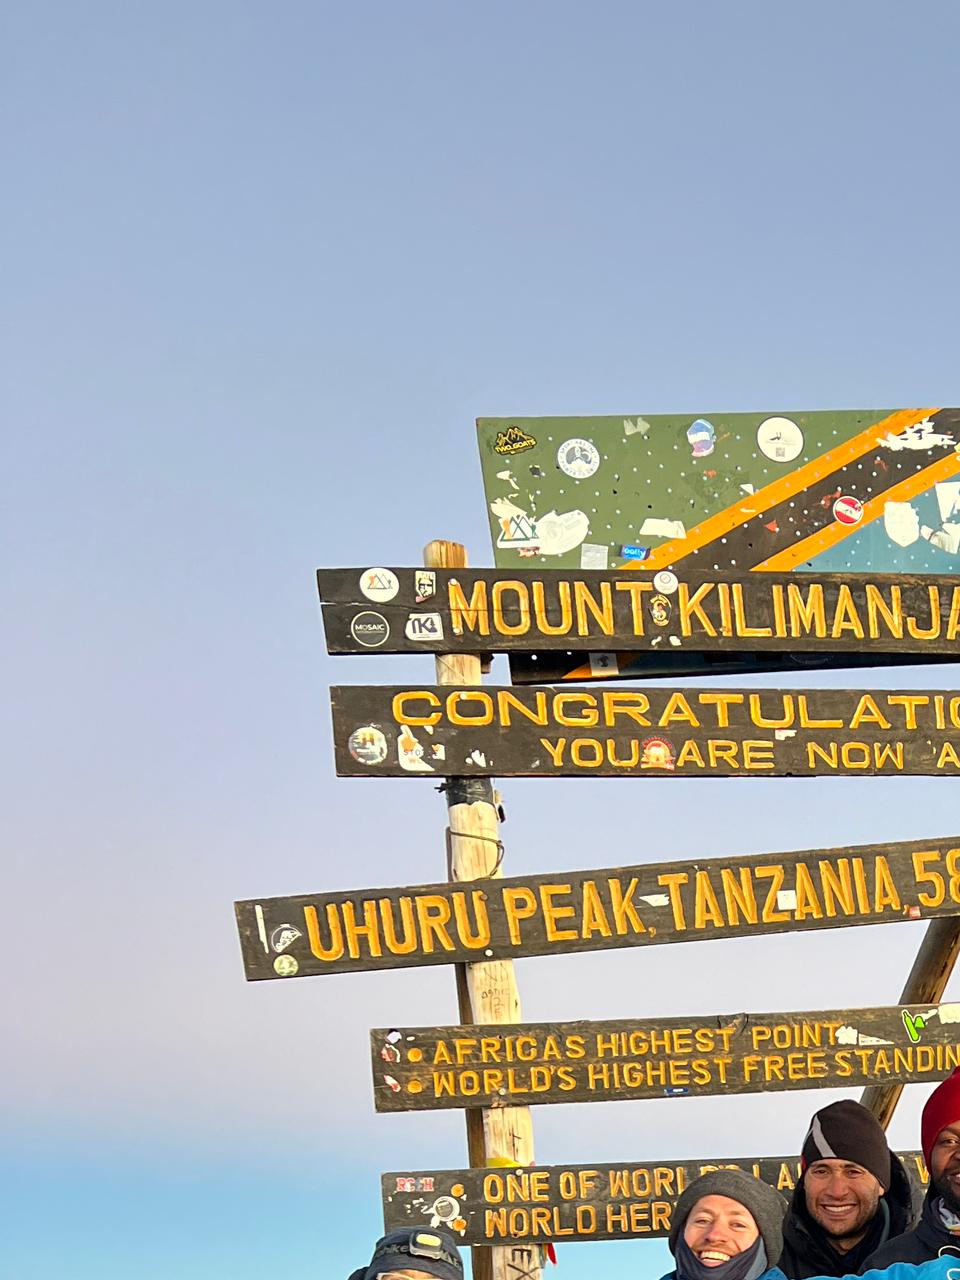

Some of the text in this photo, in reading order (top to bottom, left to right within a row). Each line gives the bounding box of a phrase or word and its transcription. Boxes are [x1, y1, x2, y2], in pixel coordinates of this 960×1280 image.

[449, 580, 654, 637] MOUNT
[539, 737, 639, 767] YOU
[676, 738, 775, 770] ARE
[806, 741, 905, 771] NOW
[303, 889, 492, 962] UHURU
[502, 877, 658, 947] PEAK,
[596, 1027, 736, 1060] HIGHEST
[751, 1021, 840, 1050] POINT
[432, 1064, 578, 1099] WORLD'S
[587, 1056, 733, 1091] HIGHEST
[743, 1050, 829, 1083] FREE
[483, 1170, 552, 1205] ONE
[559, 1169, 600, 1201] OF
[484, 1204, 599, 1239] WORLD
